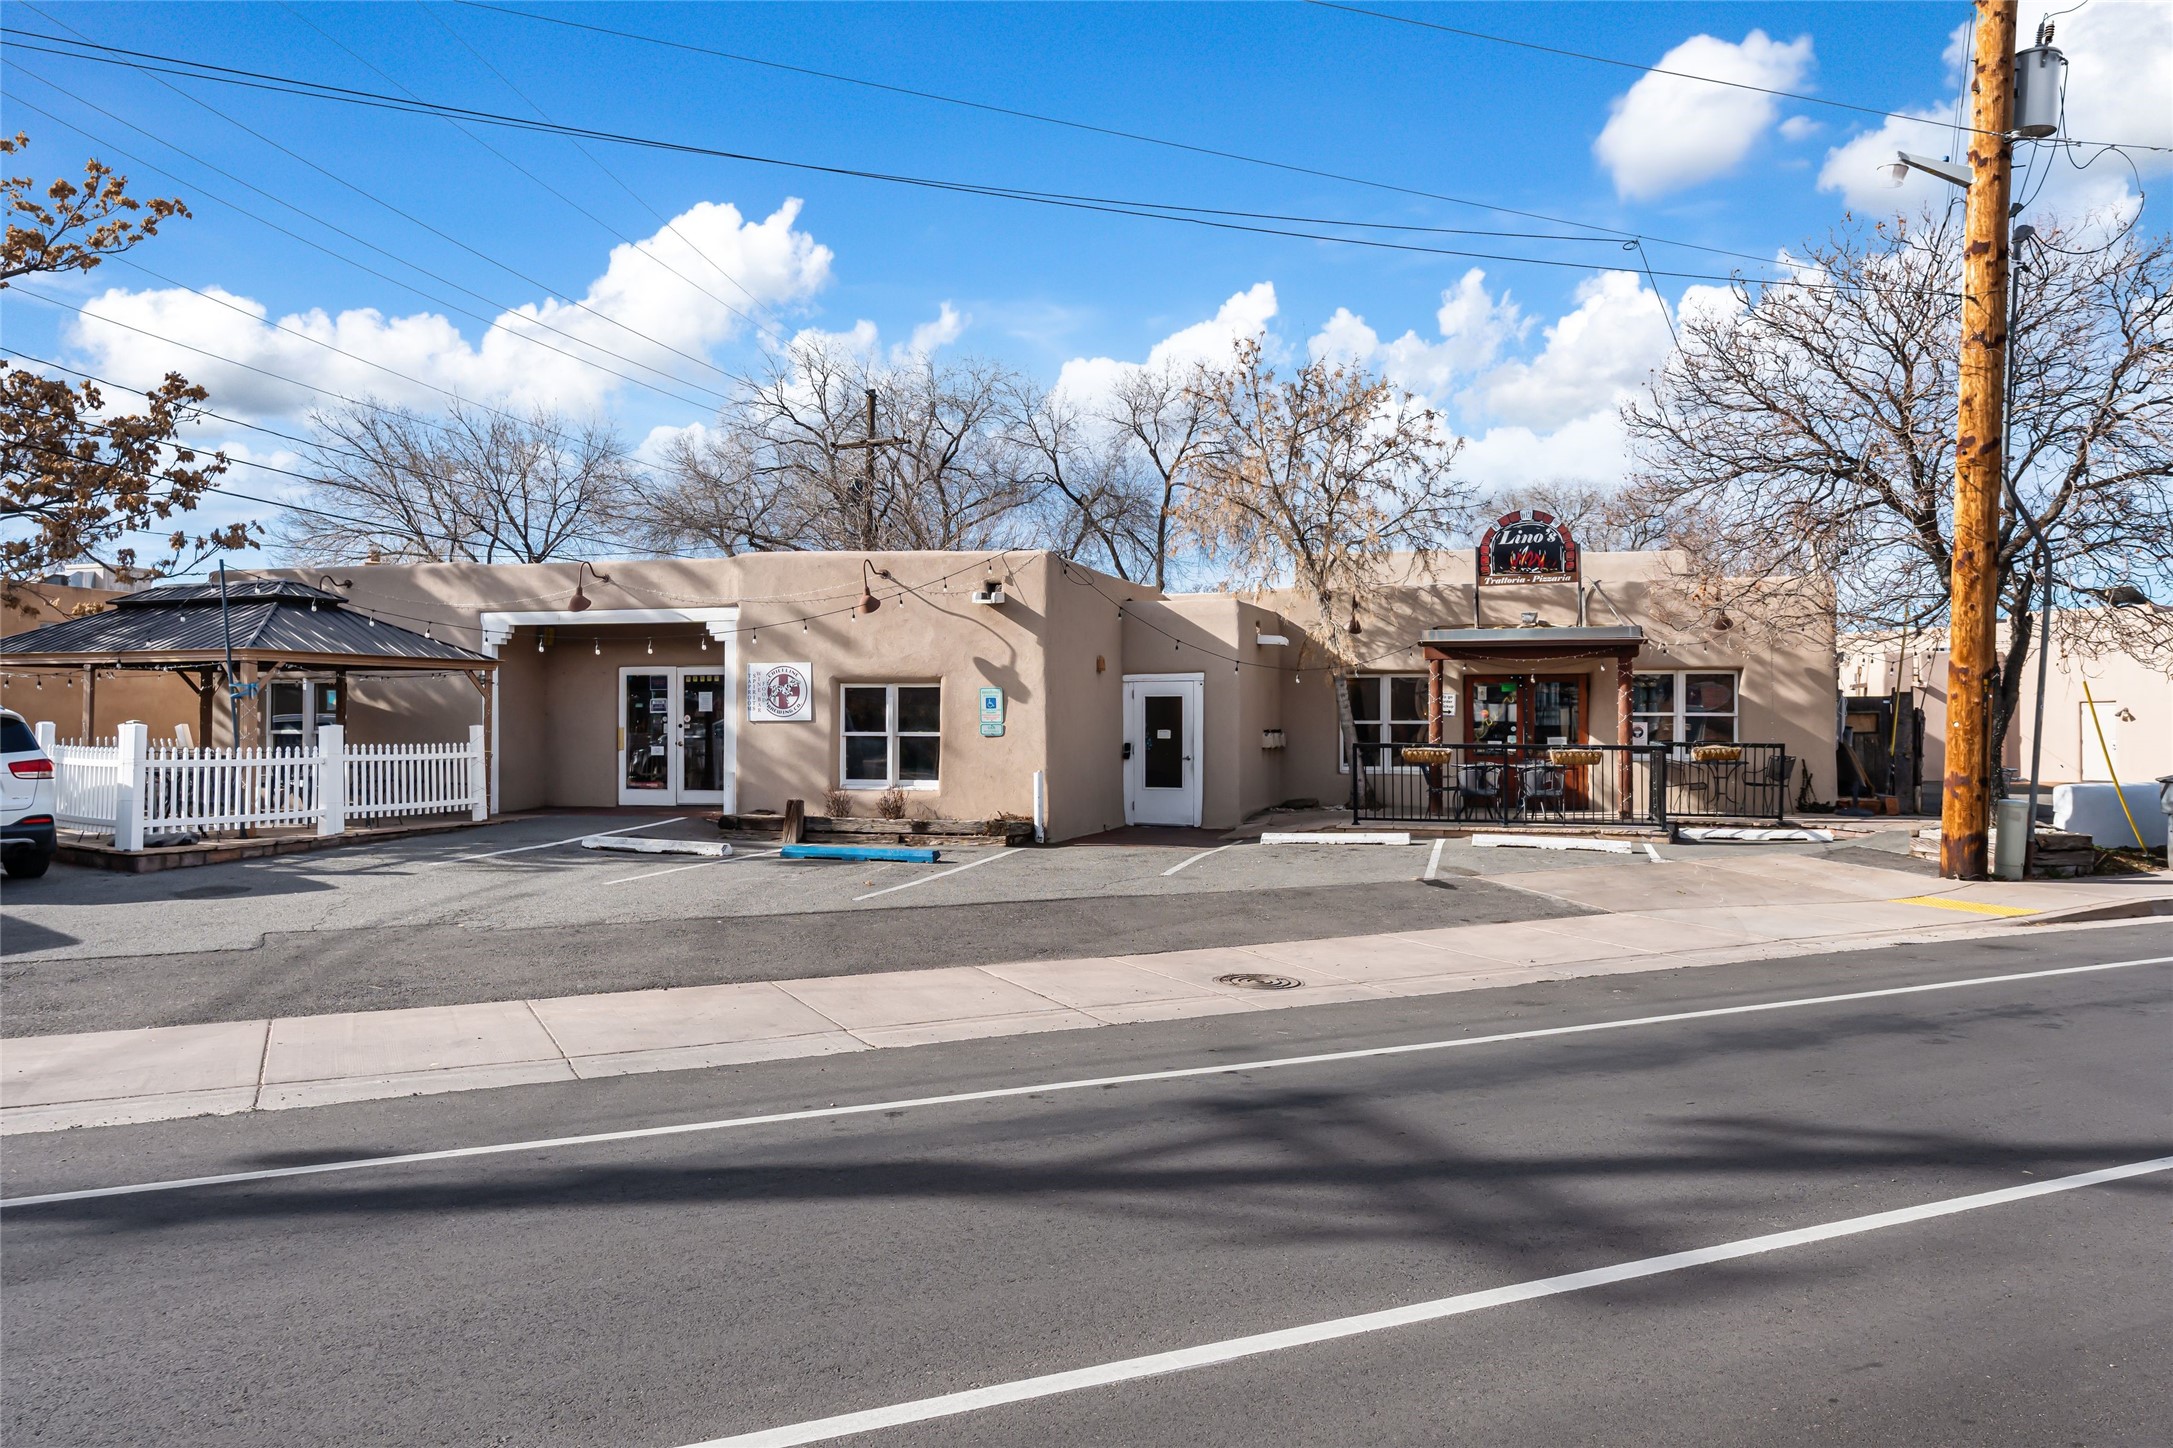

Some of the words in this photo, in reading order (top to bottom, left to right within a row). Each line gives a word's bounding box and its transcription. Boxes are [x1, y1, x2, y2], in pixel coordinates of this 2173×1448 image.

[1498, 528, 1557, 545] Lino's
[1484, 576, 1525, 584] Trattoria
[1532, 574, 1572, 582] Pizzaria
[766, 704, 793, 714] BREWING
